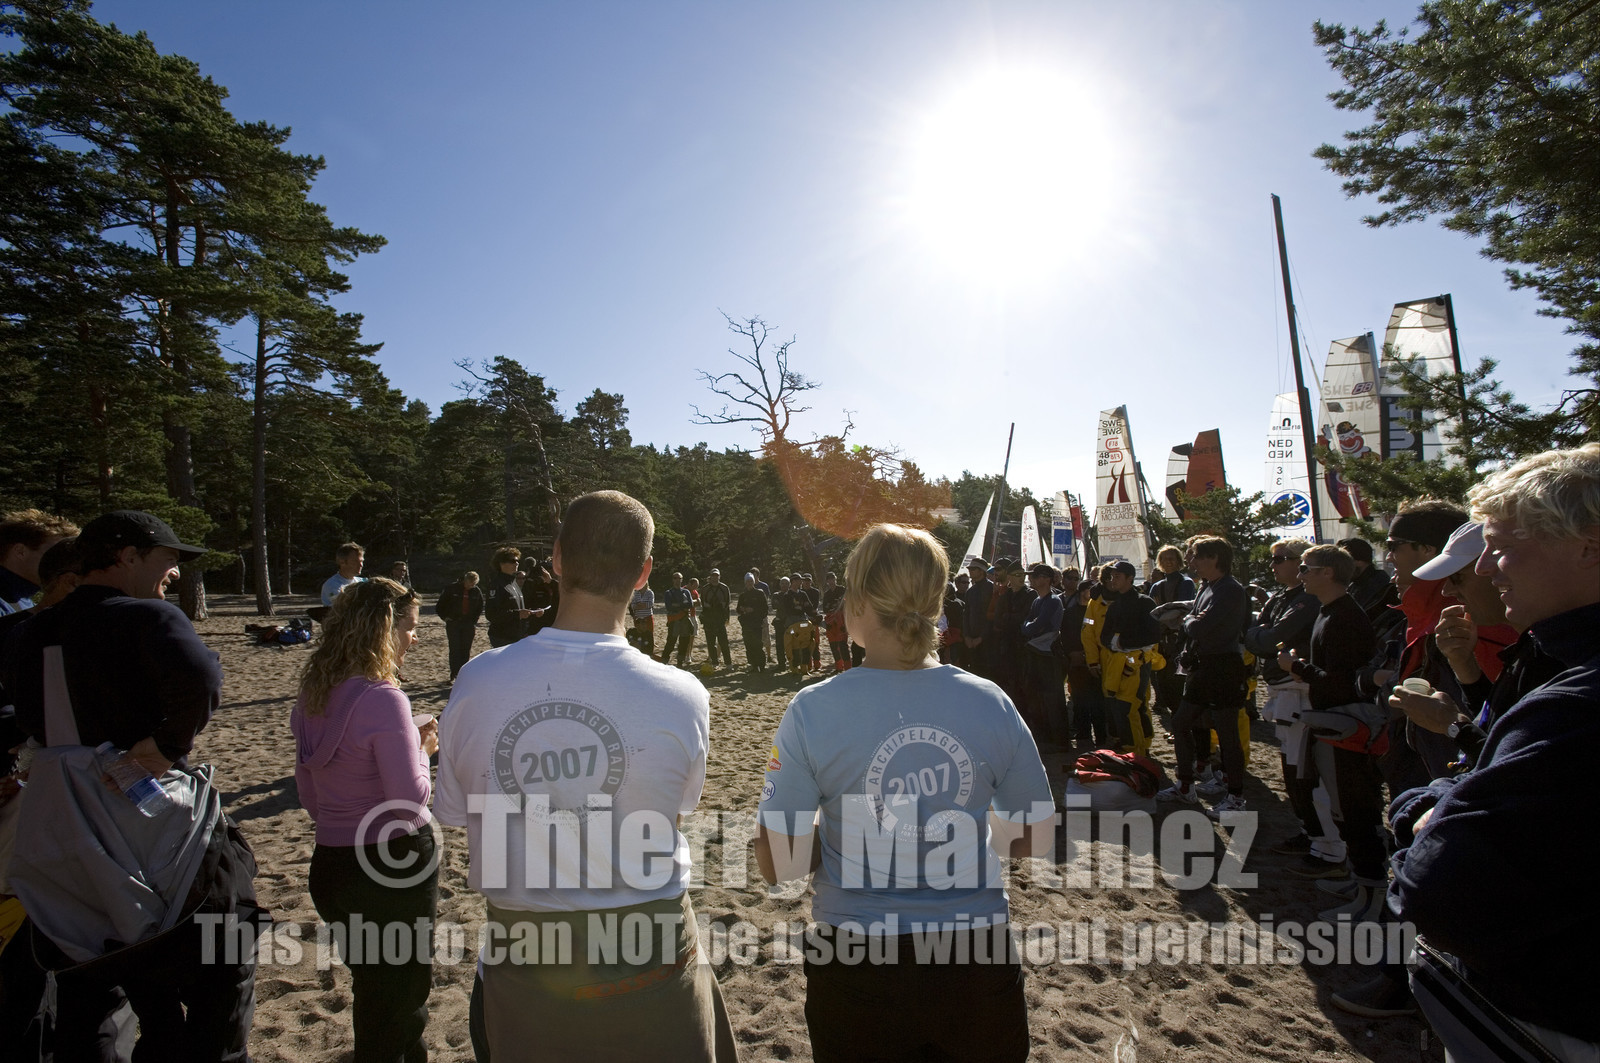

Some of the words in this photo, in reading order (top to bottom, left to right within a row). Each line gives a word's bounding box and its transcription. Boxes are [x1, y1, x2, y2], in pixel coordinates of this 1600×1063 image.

[1102, 420, 1122, 428] SWE
[1276, 466, 1283, 475] 3
[498, 704, 611, 759] ARCHIPELAGO
[607, 742, 623, 785] RAID
[520, 744, 598, 785] 2007
[868, 729, 959, 785] ARCHIPELAGO
[958, 758, 972, 797] RAID
[888, 761, 951, 807] 2007
